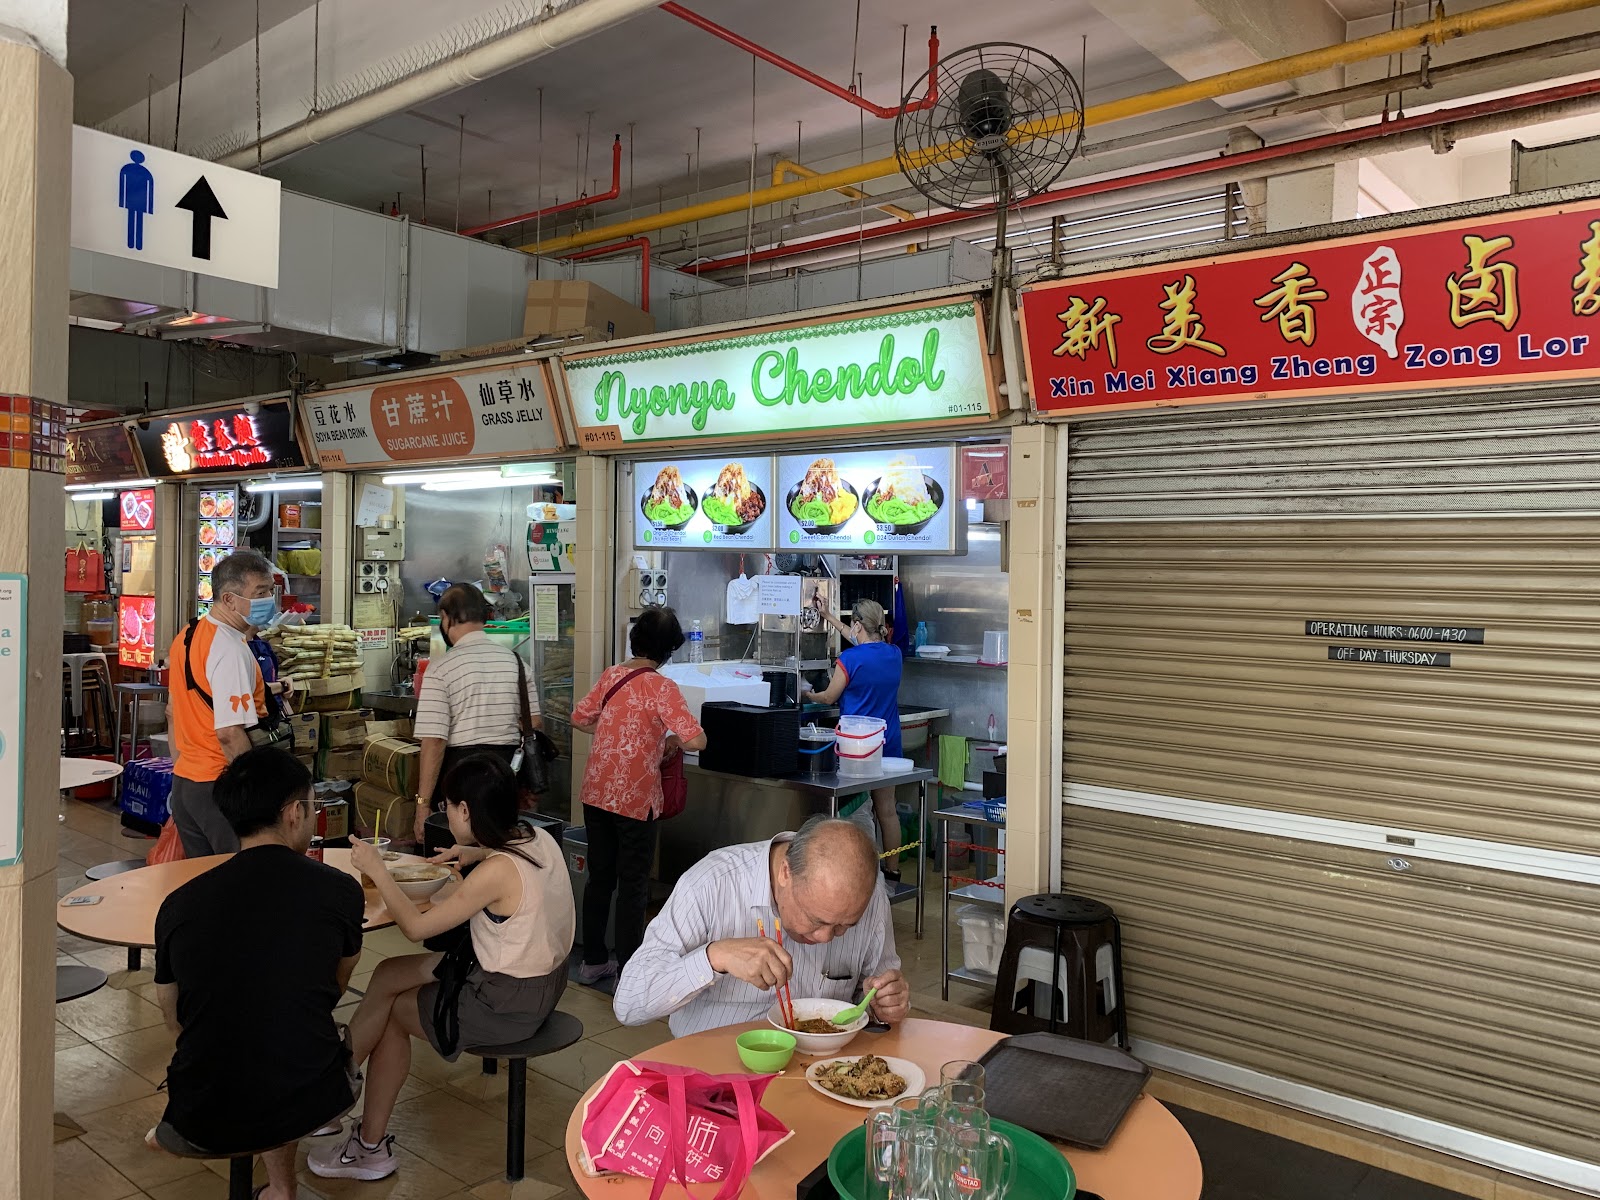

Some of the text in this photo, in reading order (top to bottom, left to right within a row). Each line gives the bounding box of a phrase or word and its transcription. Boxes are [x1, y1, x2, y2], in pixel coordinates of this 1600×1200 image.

[1359, 255, 1399, 338] 正宗
[1050, 334, 1590, 399] Xin Mei Xiang Zheng Zong Lor
[594, 328, 946, 435] Nyonya Chendol
[479, 377, 536, 407] 仙草水
[313, 401, 357, 427] 豆花水
[381, 390, 454, 428] 甘蔗汁
[481, 407, 545, 427] GRASS JELLY
[947, 403, 983, 414] #01-115
[315, 426, 368, 443] SOYA BEAN DRINK
[386, 431, 469, 452] SUGARCANE JUICE
[584, 430, 617, 443] #01-115
[1309, 621, 1369, 638] OPERATING
[0, 647, 11, 657] e
[1336, 647, 1355, 660] OFF
[1383, 649, 1437, 666] THURSDAY
[954, 1173, 980, 1189] TSINGTAO
